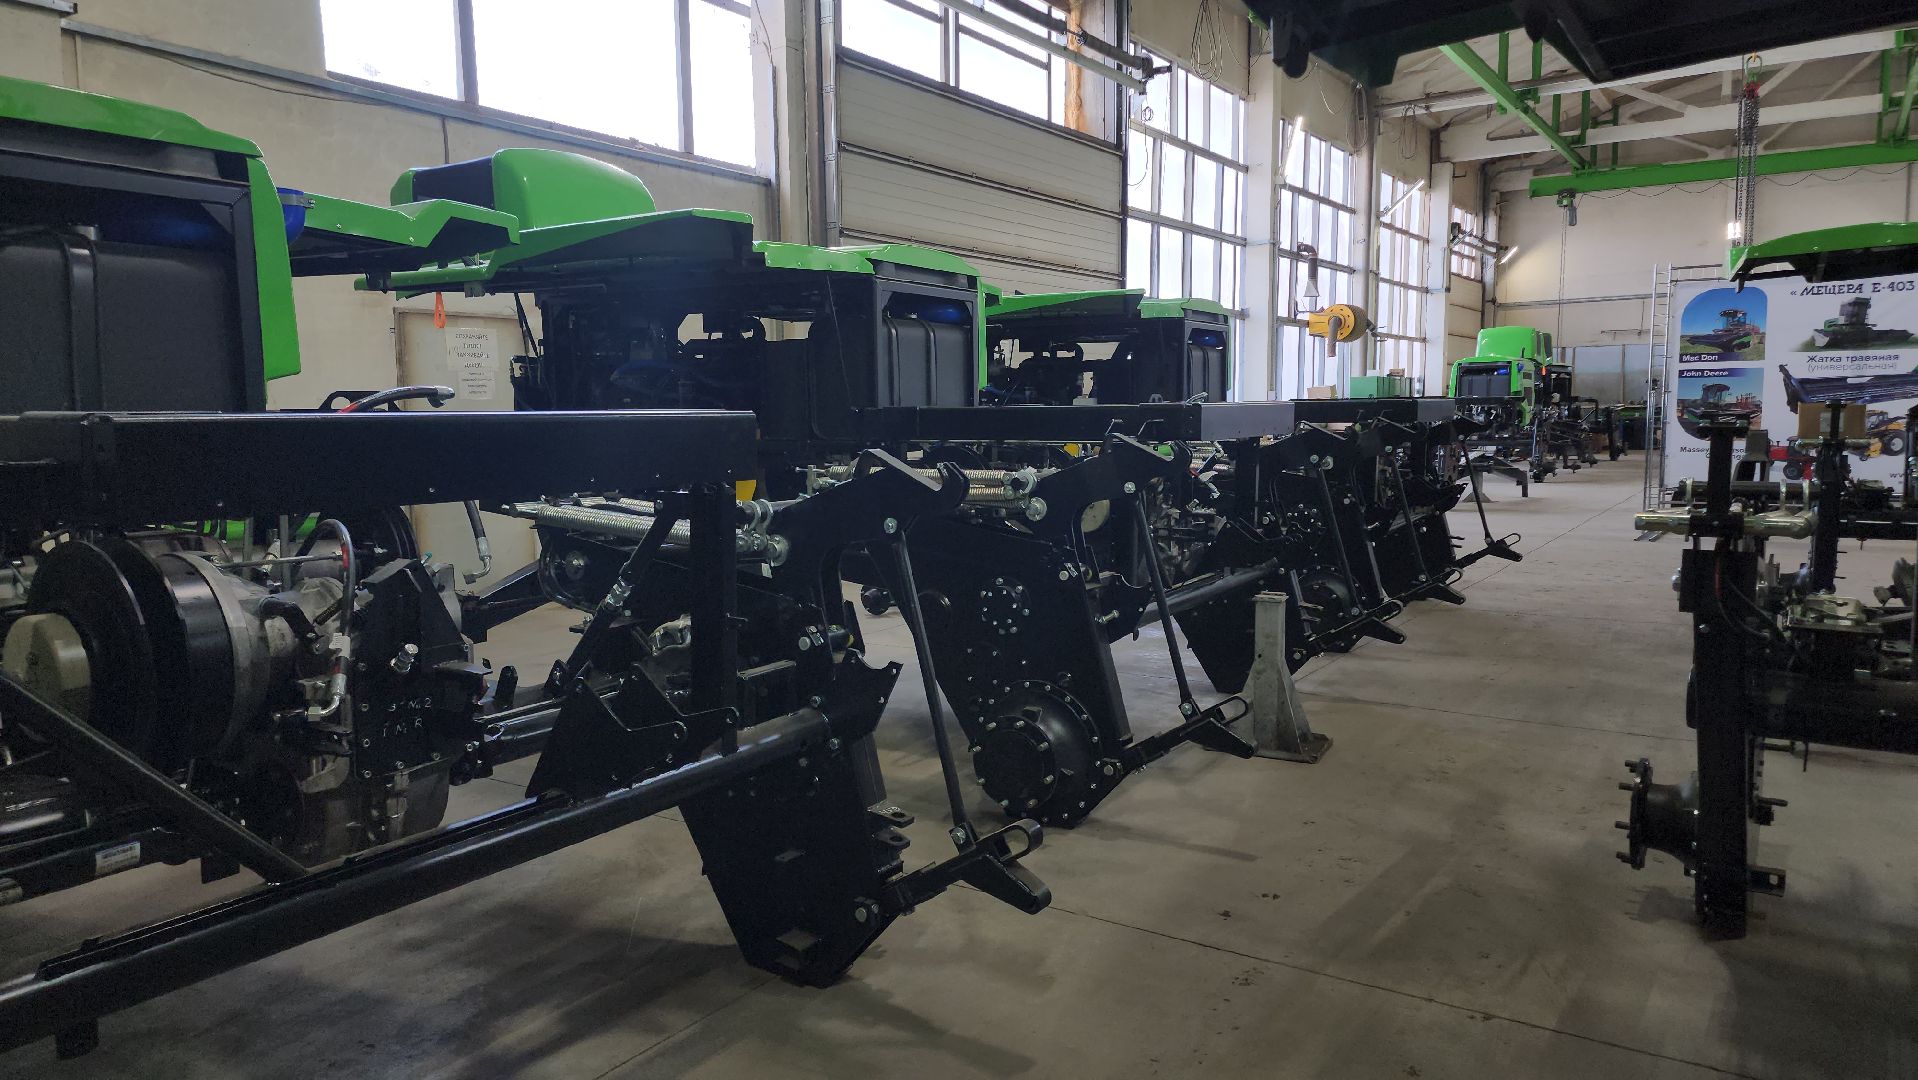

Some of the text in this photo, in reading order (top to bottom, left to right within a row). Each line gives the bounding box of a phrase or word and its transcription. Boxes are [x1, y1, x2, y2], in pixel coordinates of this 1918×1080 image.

[1682, 354, 1700, 362] Mac
[1807, 354, 1900, 363] Жатка травяная
[1680, 447, 1710, 455] Massey
